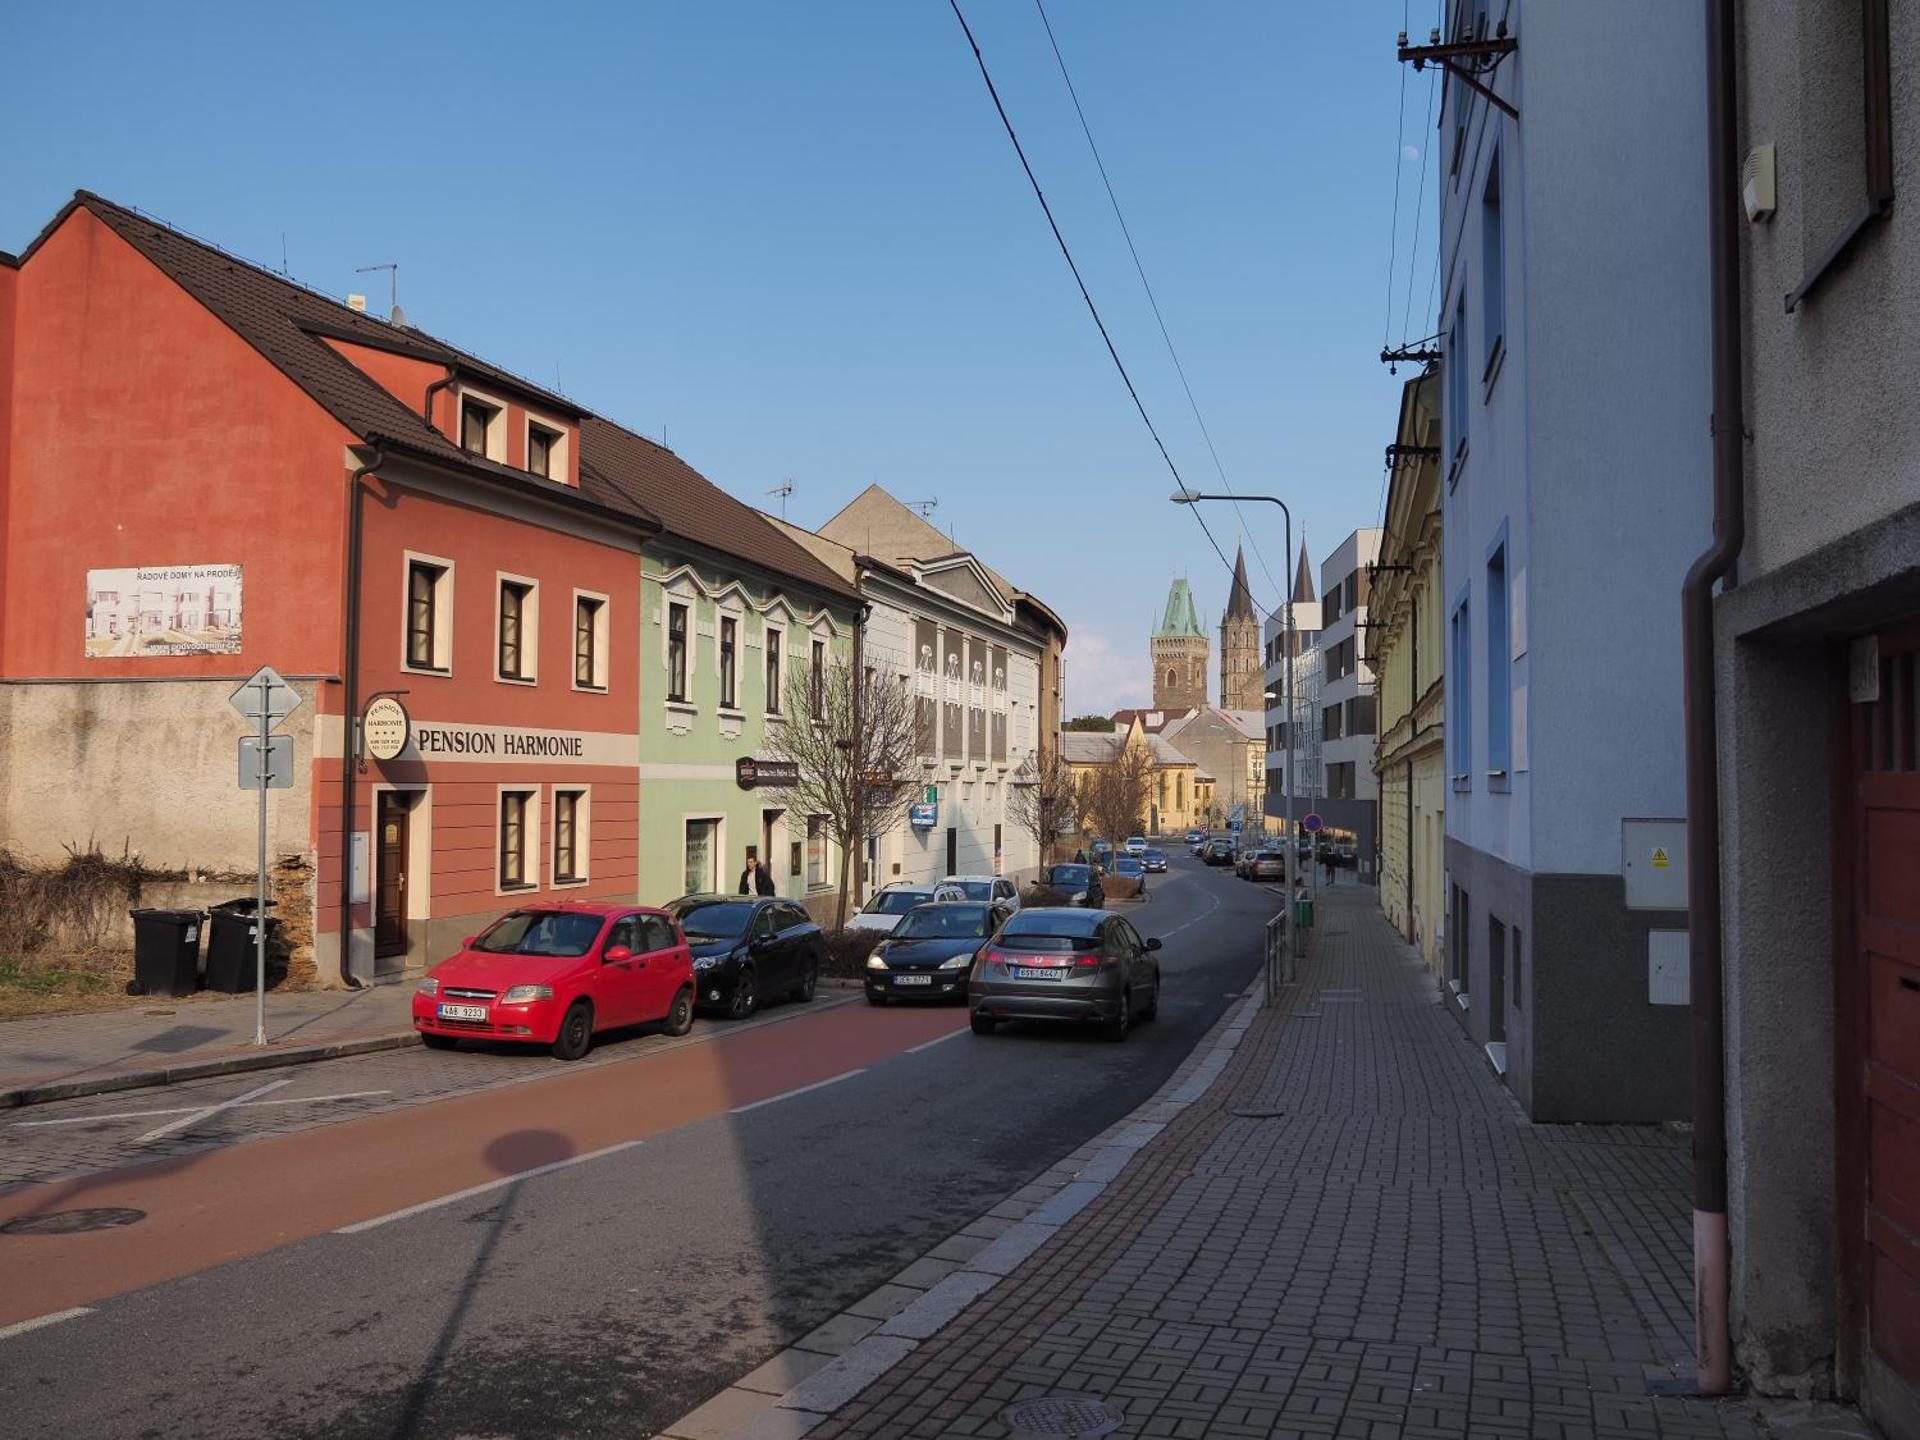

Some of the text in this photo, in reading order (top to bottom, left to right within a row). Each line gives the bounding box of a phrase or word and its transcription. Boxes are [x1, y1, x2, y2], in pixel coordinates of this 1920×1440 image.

[170, 571, 193, 580] DOMY
[194, 570, 205, 579] NA
[370, 704, 401, 716] PENSION
[418, 729, 583, 757] PENSION HARMONIE
[463, 1007, 482, 1017] 9233
